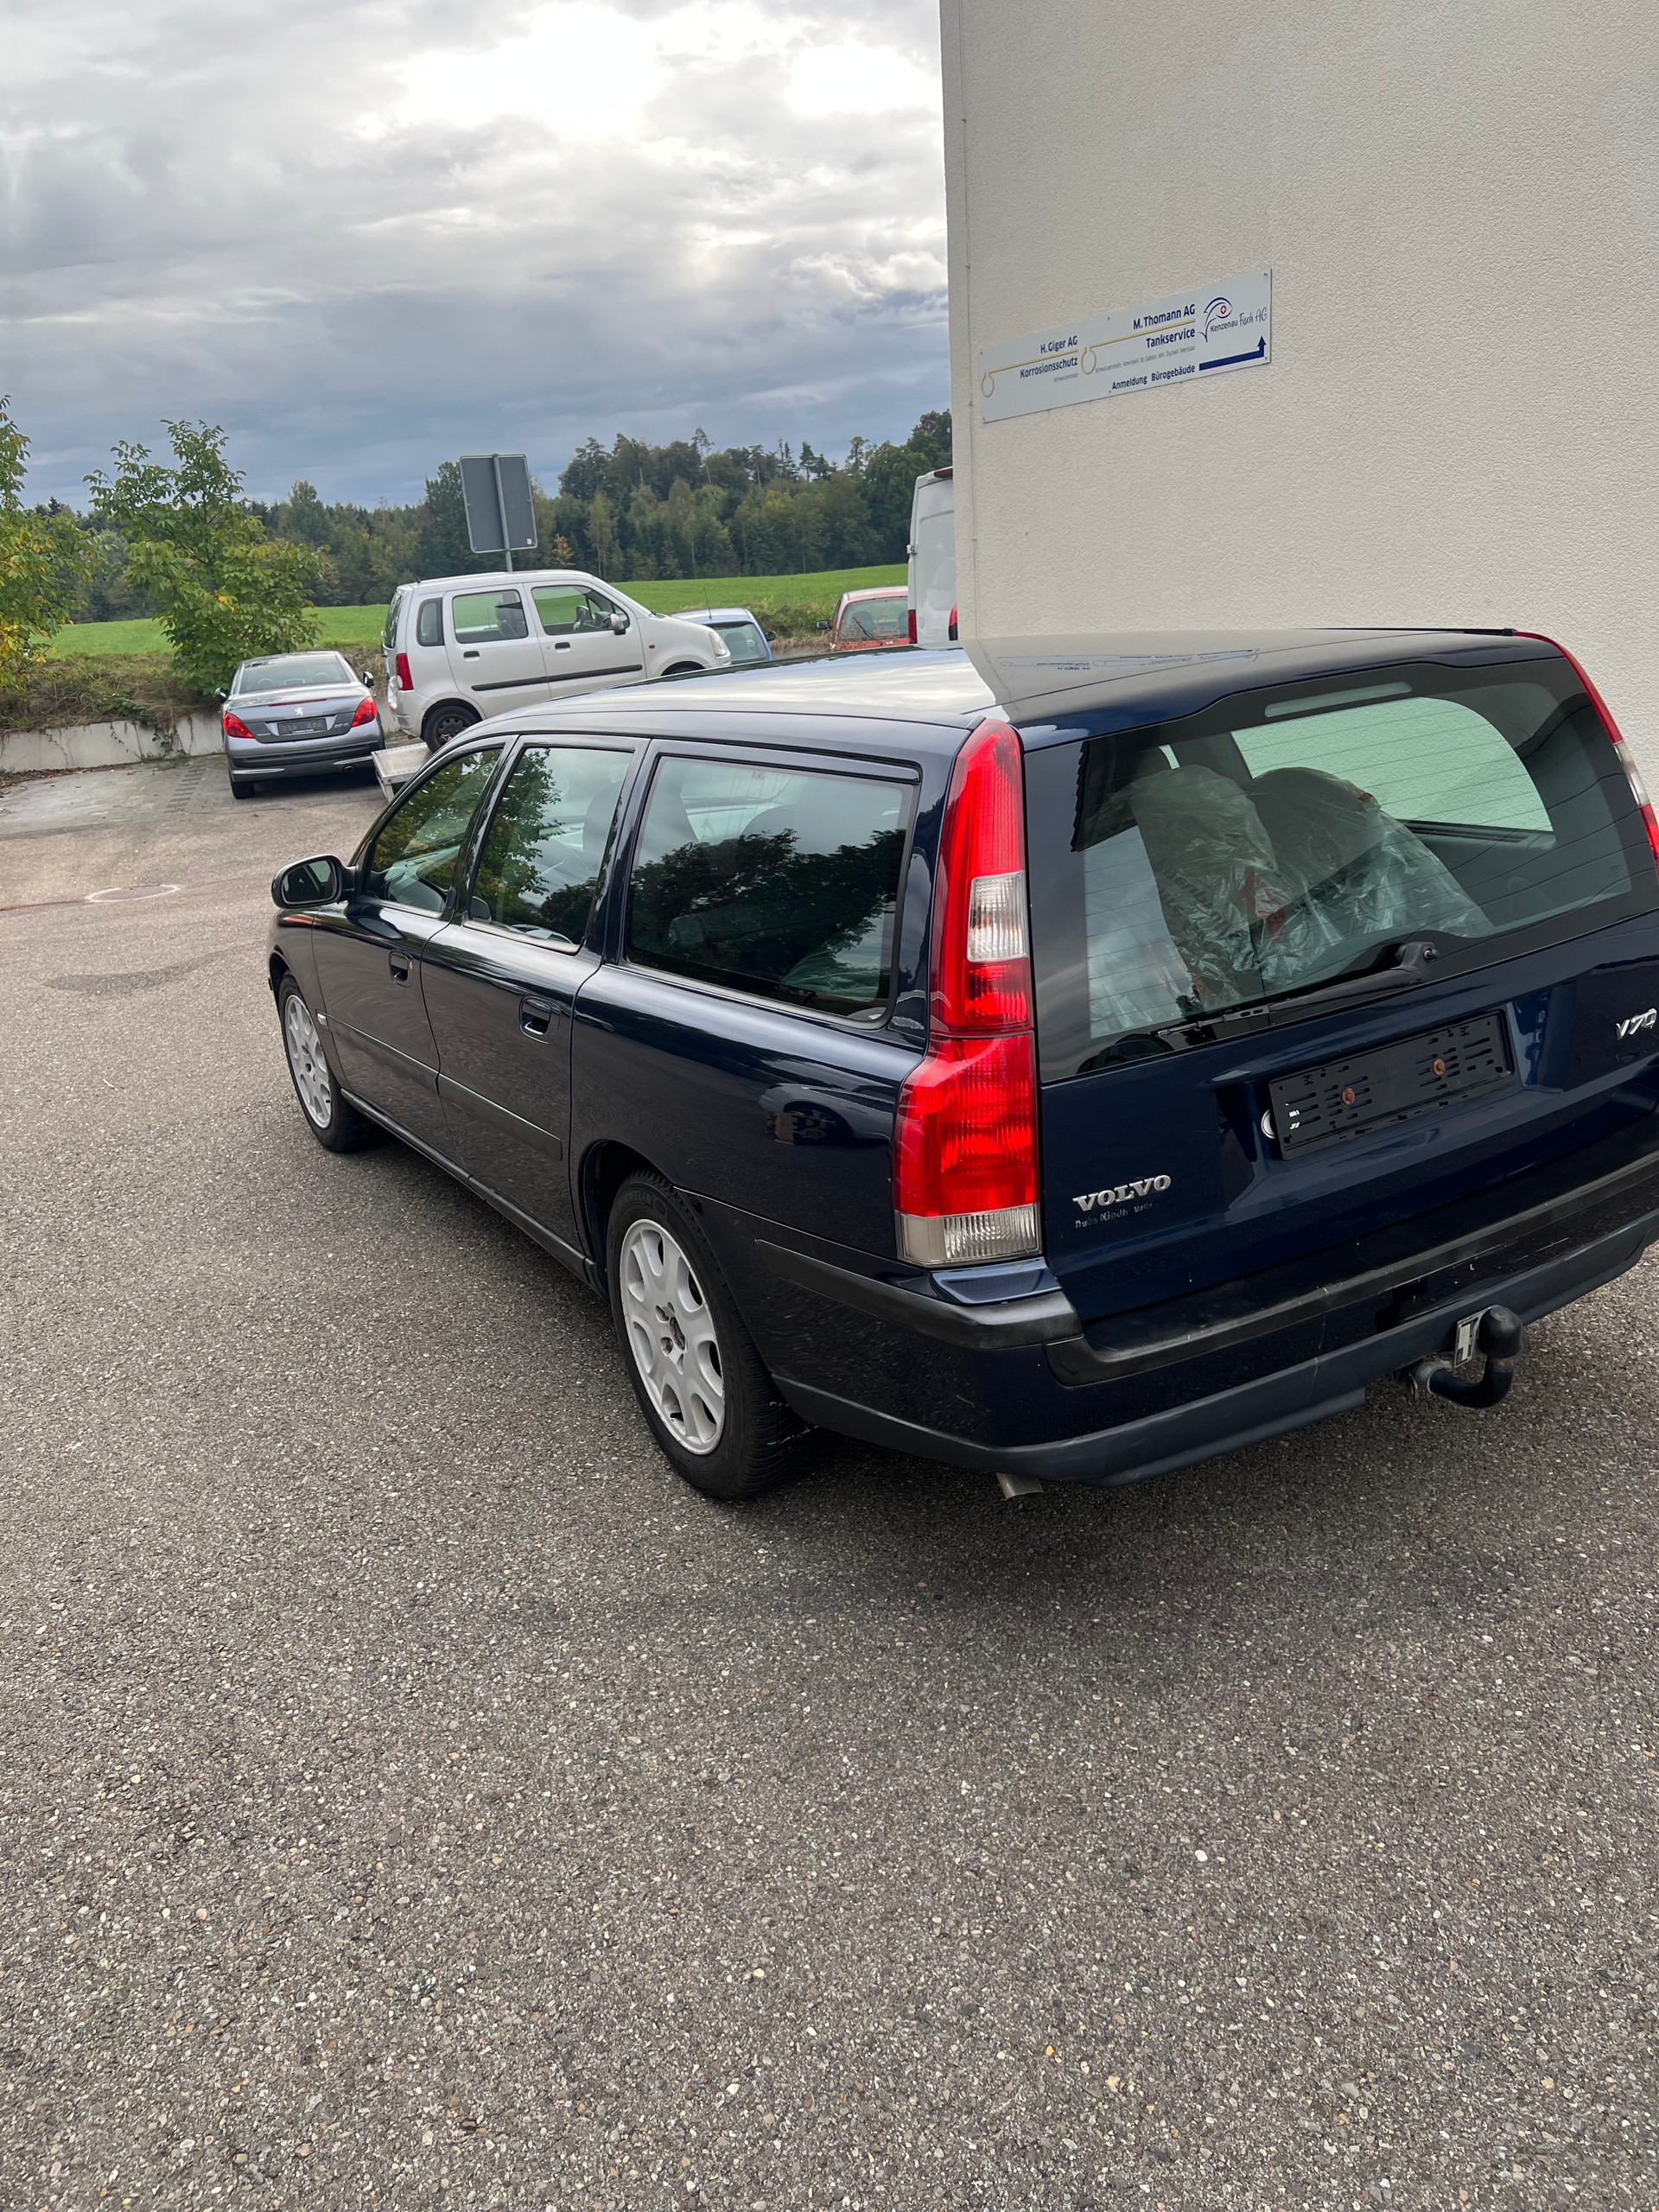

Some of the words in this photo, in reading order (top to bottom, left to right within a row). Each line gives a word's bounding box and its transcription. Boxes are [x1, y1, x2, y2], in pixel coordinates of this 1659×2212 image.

[1133, 320, 1143, 329] M.
[1143, 309, 1181, 327] Thomann
[1183, 303, 1196, 316] AG
[1210, 320, 1238, 333] Kenzenau
[1239, 312, 1254, 327] Fisch
[1255, 307, 1268, 323] AG
[1040, 344, 1048, 353] H.
[1048, 340, 1066, 352] Giger
[1067, 335, 1077, 347] AG
[1146, 327, 1196, 348] Tankservice
[1020, 357, 1078, 378] Korrosionsschutz
[1111, 375, 1147, 391] Anmeldung
[1151, 364, 1196, 382] Bürogebäude
[1616, 1007, 1657, 1040] V70
[1072, 1174, 1173, 1212] VOLVO
